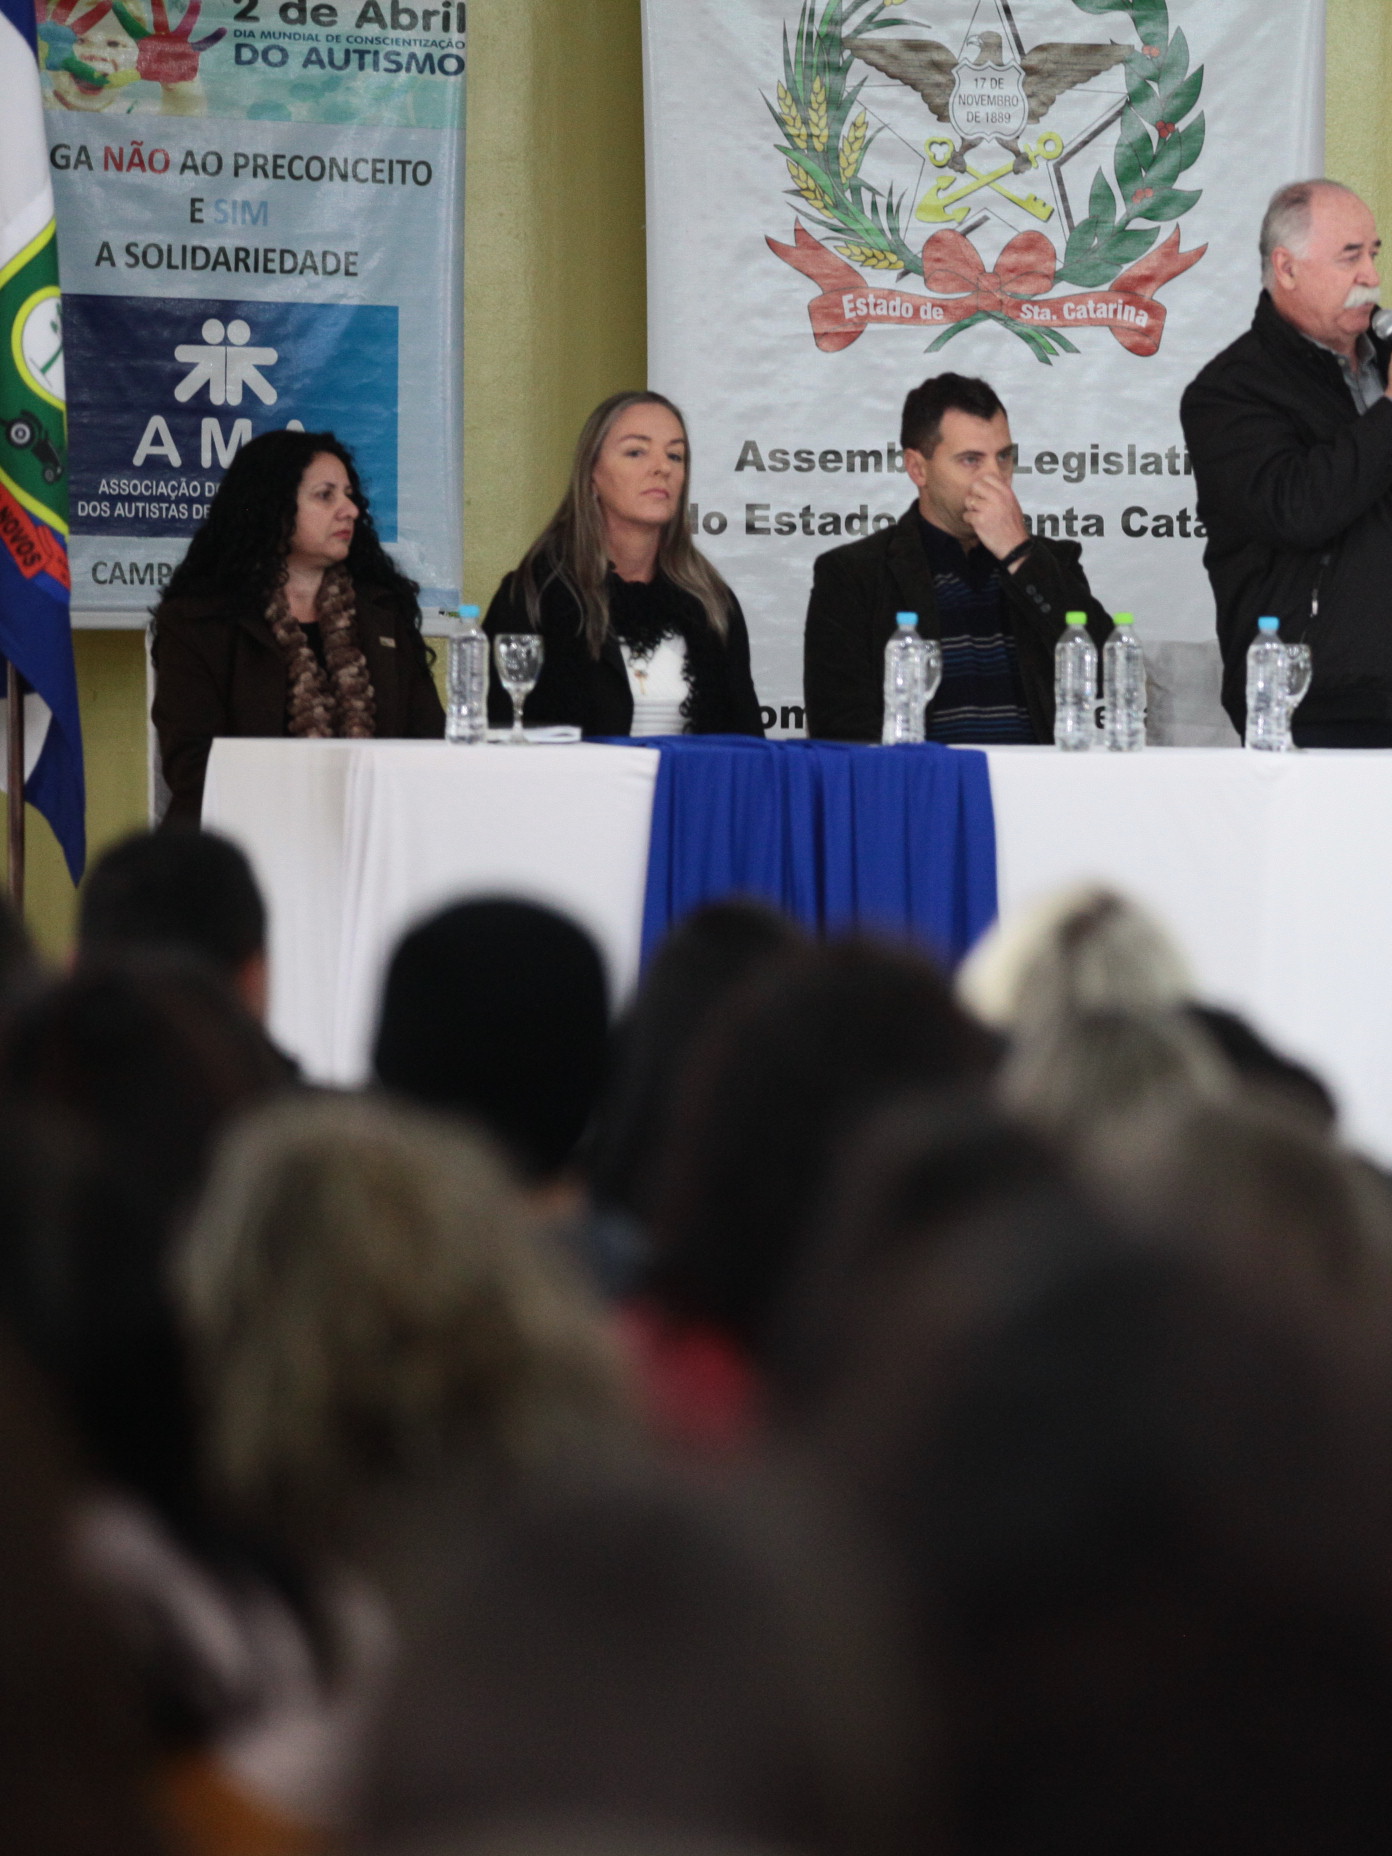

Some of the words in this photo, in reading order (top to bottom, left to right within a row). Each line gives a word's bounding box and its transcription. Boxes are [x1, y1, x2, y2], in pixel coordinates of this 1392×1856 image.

[233, 0, 260, 22] 2
[279, 0, 338, 27] de
[355, 0, 466, 34] Abril
[233, 29, 256, 39] DIA
[260, 31, 321, 43] MUNDIAL
[325, 34, 342, 43] DE
[346, 35, 466, 50] CONSCIENTIZAÇÃO
[234, 43, 289, 68] DO
[302, 47, 466, 77] AUTISMO
[974, 77, 987, 89] 17
[990, 77, 1005, 90] DE
[958, 94, 1019, 107] NOVEMBRO
[966, 111, 981, 123] DE
[985, 111, 1011, 124] 1889
[50, 143, 93, 171] GA
[103, 141, 170, 174] NÃO
[179, 150, 223, 178] AO
[233, 153, 433, 187] PRECONCEITO
[190, 198, 205, 224] E
[213, 199, 269, 227] SIM
[95, 241, 116, 268] A
[124, 242, 359, 277] SOLIDARIEDADE
[842, 293, 914, 320] Estado
[918, 303, 945, 320] de
[1018, 303, 1058, 321] Sta.
[1062, 299, 1150, 328] Catarina
[734, 440, 907, 473] Assemb
[1012, 443, 1194, 484] Legislati
[98, 477, 201, 501] ASSOCIAÇÃO
[77, 501, 111, 517] DOS
[114, 502, 189, 519] AUTISTAS
[745, 503, 898, 536] Estado
[91, 560, 183, 586] CAMP
